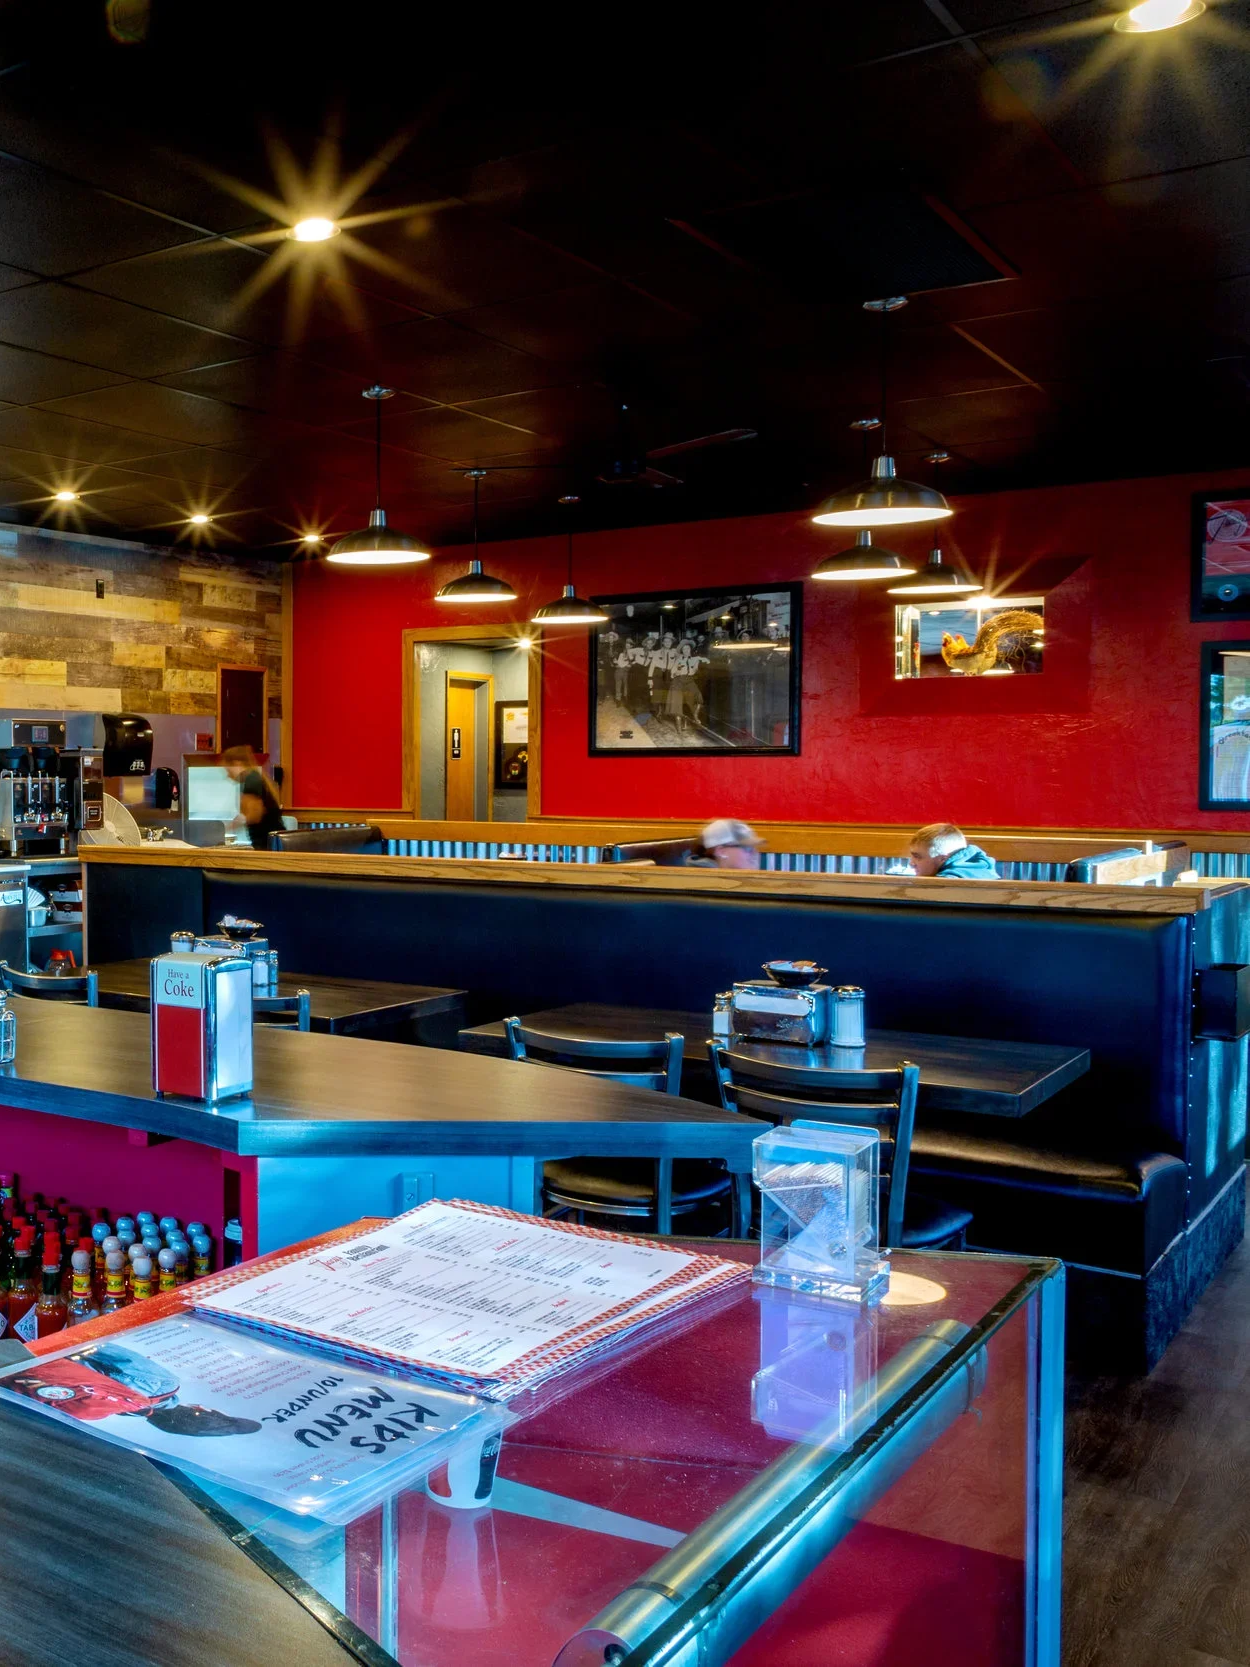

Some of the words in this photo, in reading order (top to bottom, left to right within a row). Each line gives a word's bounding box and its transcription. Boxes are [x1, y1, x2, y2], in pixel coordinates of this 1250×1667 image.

[164, 978, 195, 998] Coke
[167, 968, 184, 979] Have
[185, 972, 190, 980] a
[261, 1376, 344, 1423] 10/UNDER
[294, 1386, 395, 1449] MENU
[350, 1402, 440, 1454] KIDS
